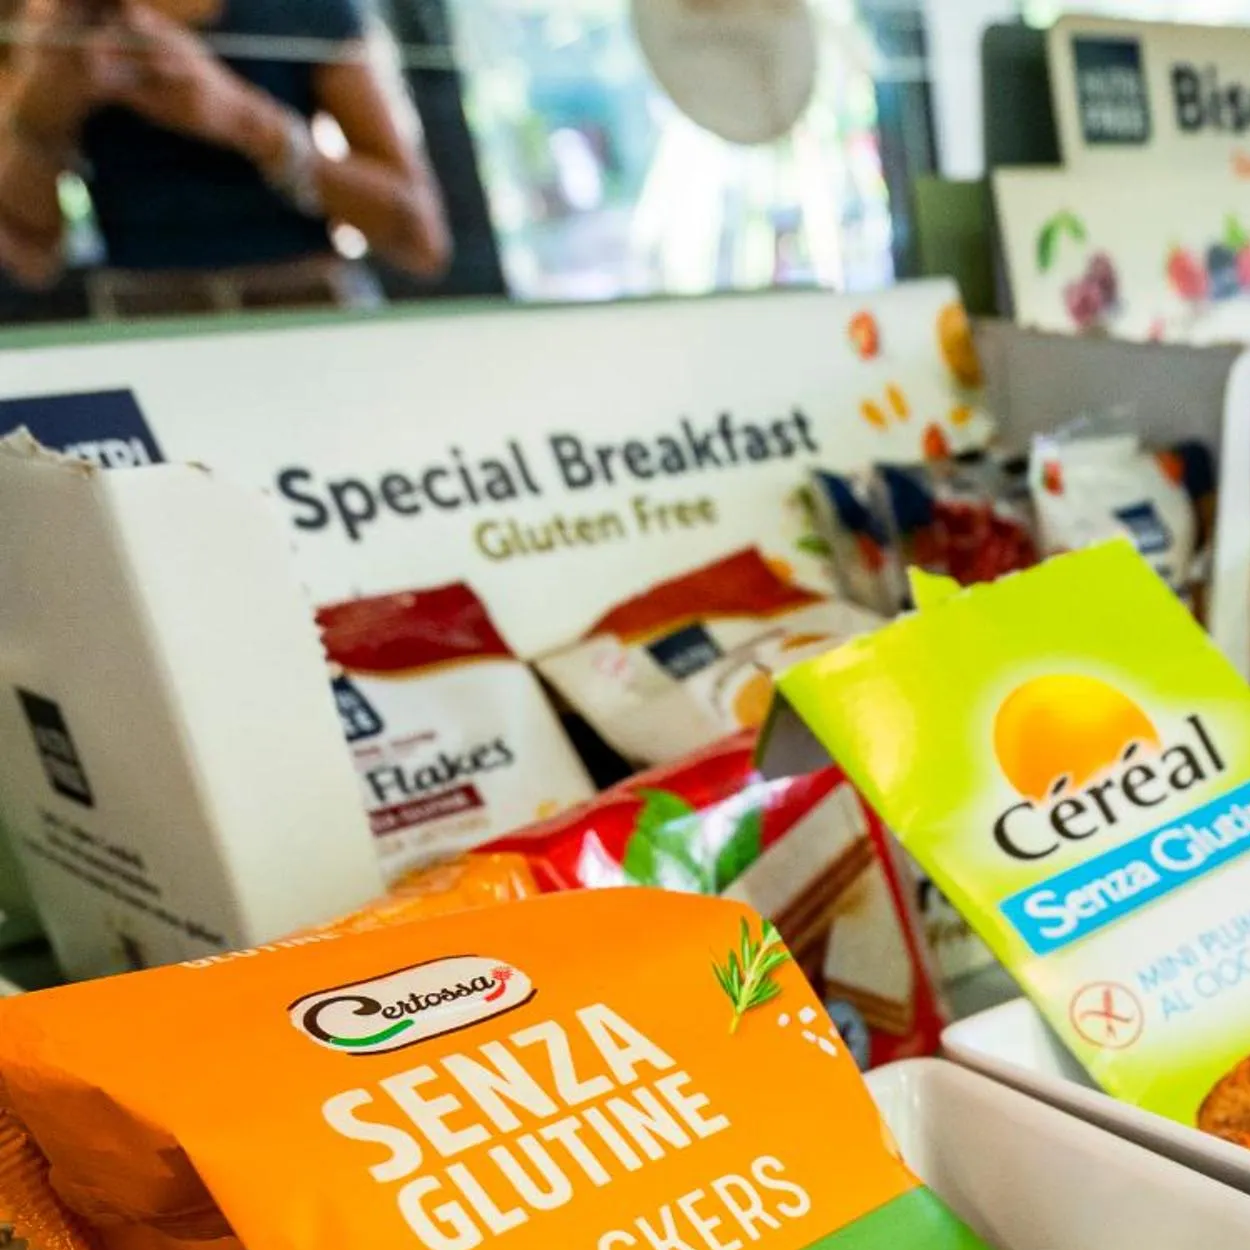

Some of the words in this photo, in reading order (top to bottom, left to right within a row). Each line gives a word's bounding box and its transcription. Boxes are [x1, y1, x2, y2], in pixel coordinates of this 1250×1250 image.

[277, 441, 540, 541] Special
[549, 409, 818, 489] Breakfast
[473, 511, 626, 561] Gluten
[632, 495, 718, 532] Free
[365, 737, 516, 803] Flakes
[992, 713, 1226, 861] Céréal
[1023, 859, 1161, 939] Senza
[303, 967, 514, 1047] Certossa
[1137, 944, 1199, 992] MINI
[1162, 988, 1193, 1021] AL
[320, 1003, 676, 1183] SENZA
